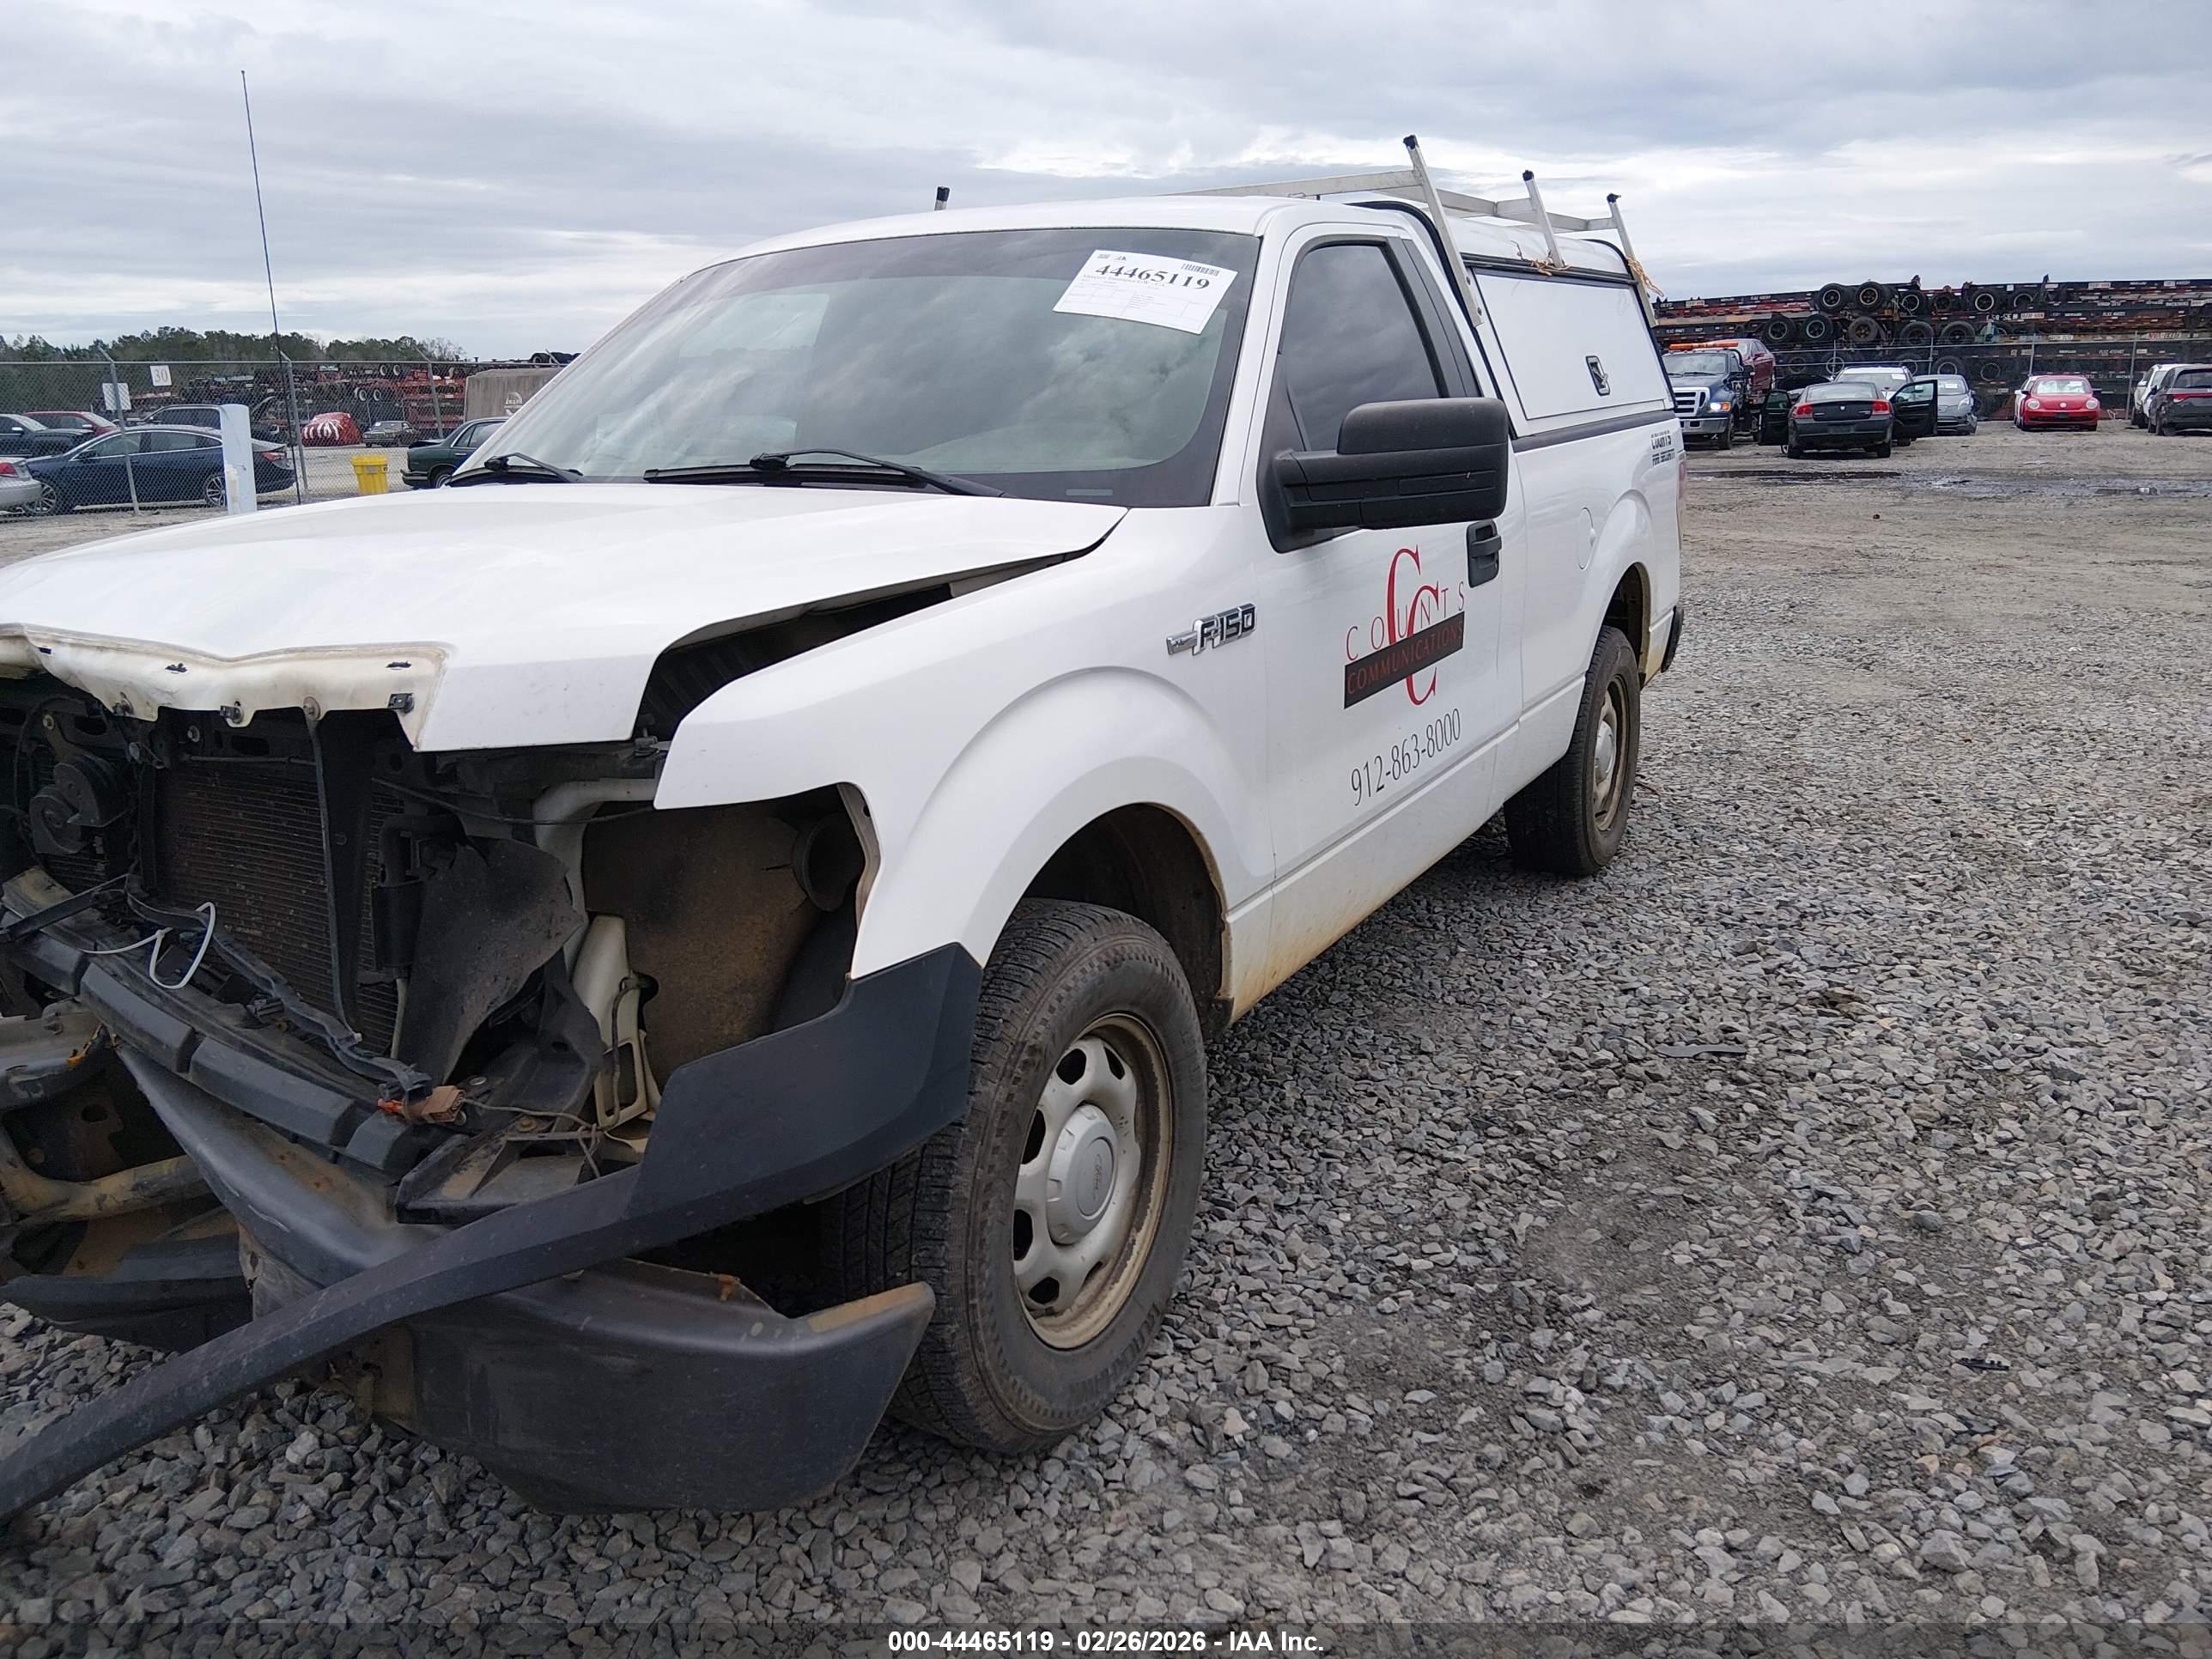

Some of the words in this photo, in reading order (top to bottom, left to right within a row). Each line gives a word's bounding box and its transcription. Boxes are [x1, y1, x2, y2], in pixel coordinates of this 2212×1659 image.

[1095, 264, 1211, 290] 44465119
[155, 369, 168, 383] 30
[1192, 601, 1257, 656] F-150
[1346, 580, 1465, 661] COUNTS
[1346, 620, 1463, 696] COMMUNICATIONS
[1351, 708, 1462, 806] 912-863-8000
